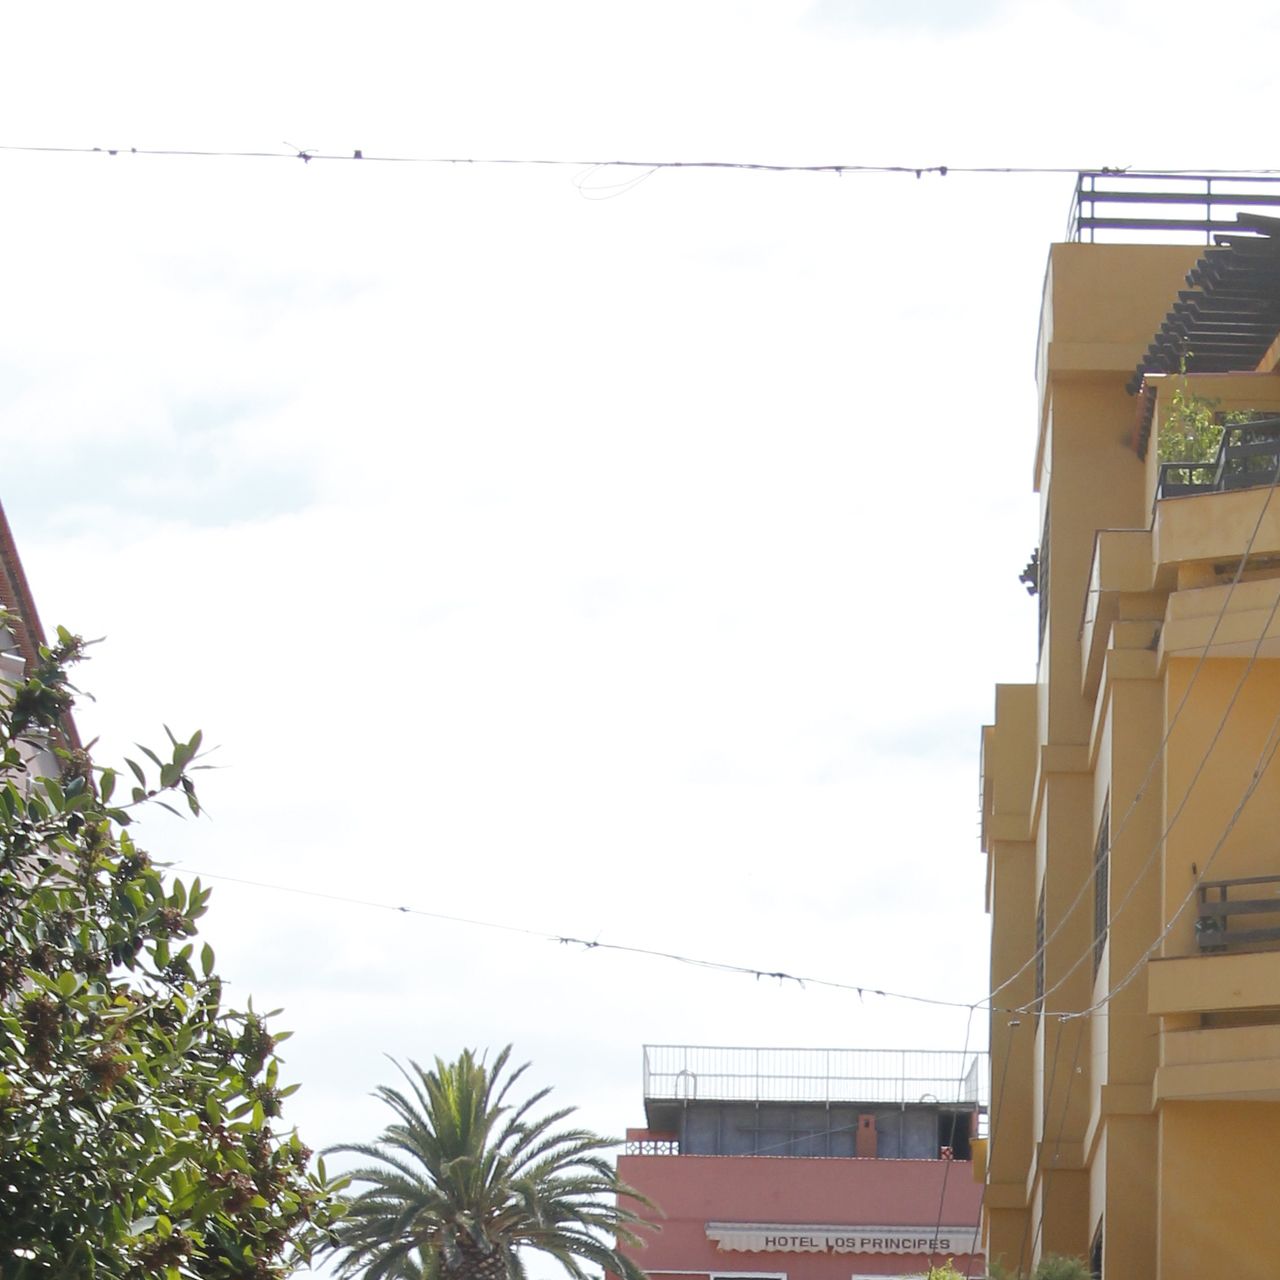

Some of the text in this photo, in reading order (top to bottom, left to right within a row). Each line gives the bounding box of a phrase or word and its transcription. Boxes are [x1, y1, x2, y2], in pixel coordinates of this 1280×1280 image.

[764, 1236, 951, 1250] HOTEL LOS PRINCIPES
